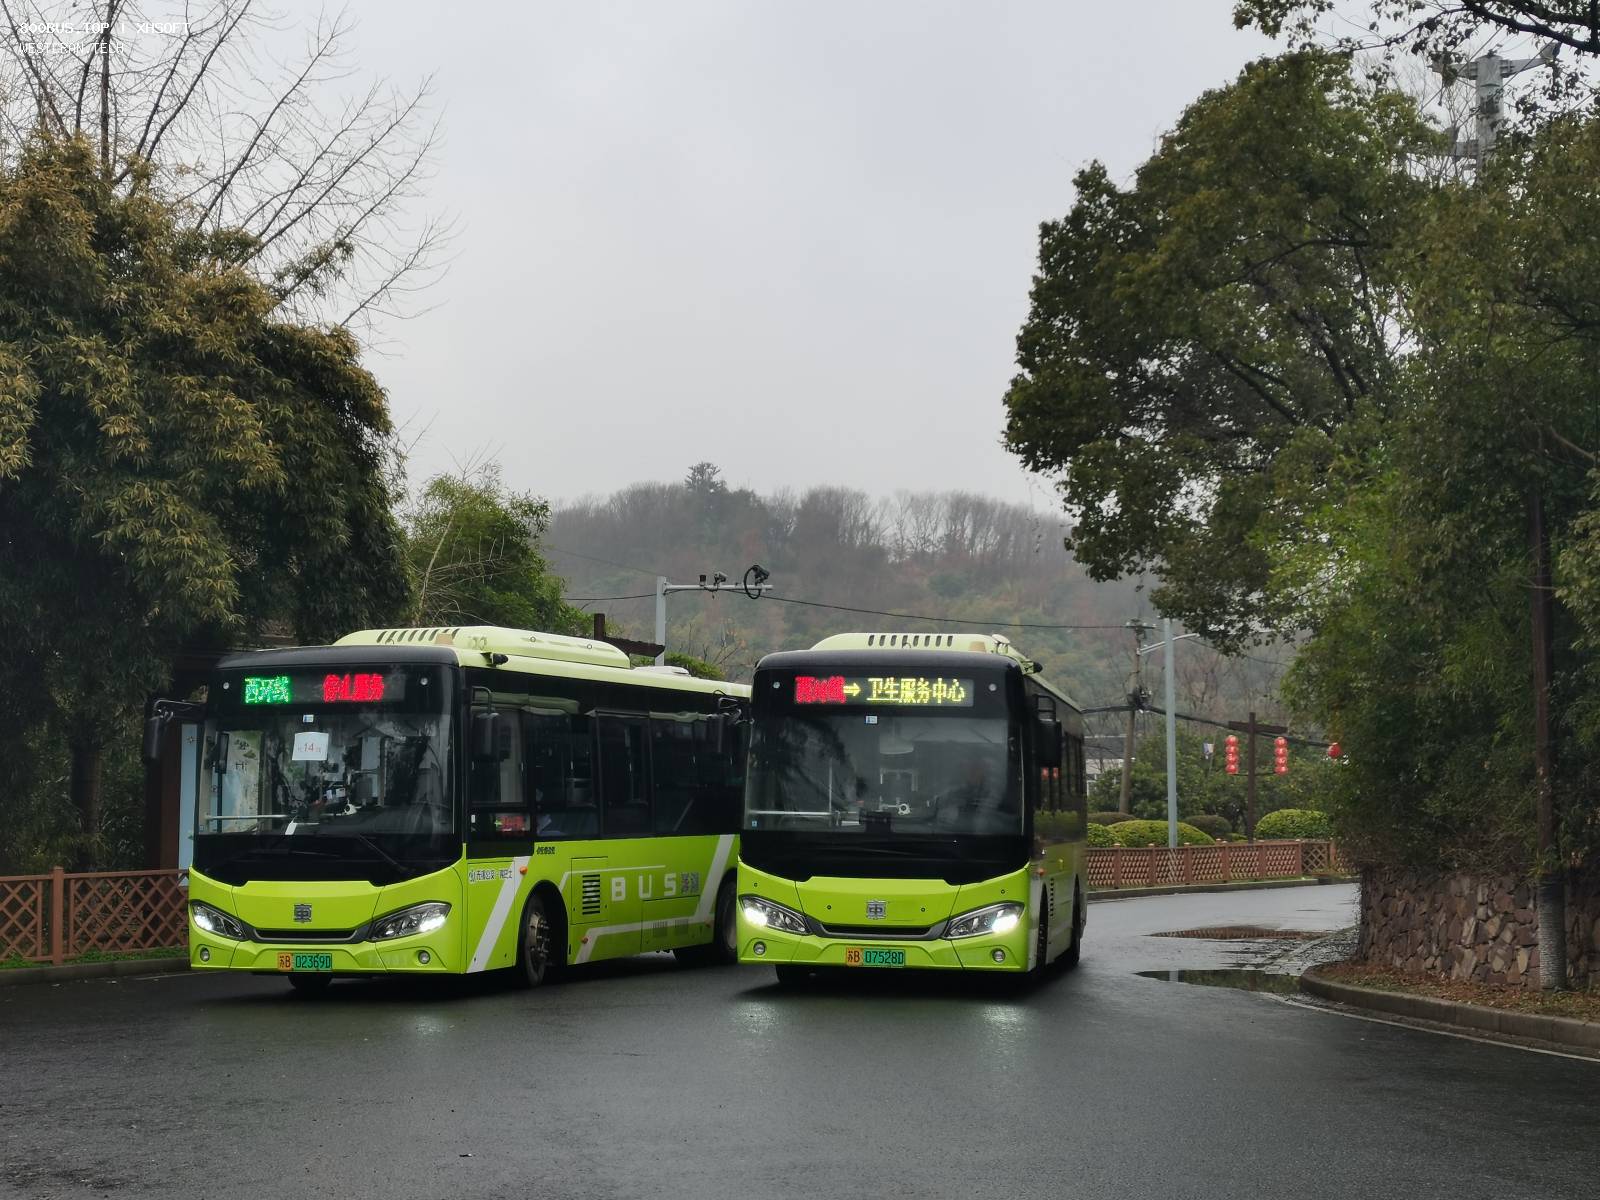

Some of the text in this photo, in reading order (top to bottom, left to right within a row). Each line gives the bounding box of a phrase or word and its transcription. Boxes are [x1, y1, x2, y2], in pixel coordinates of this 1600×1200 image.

[866, 676, 966, 704] 卫生服务中心
[865, 950, 904, 965] 07528D
